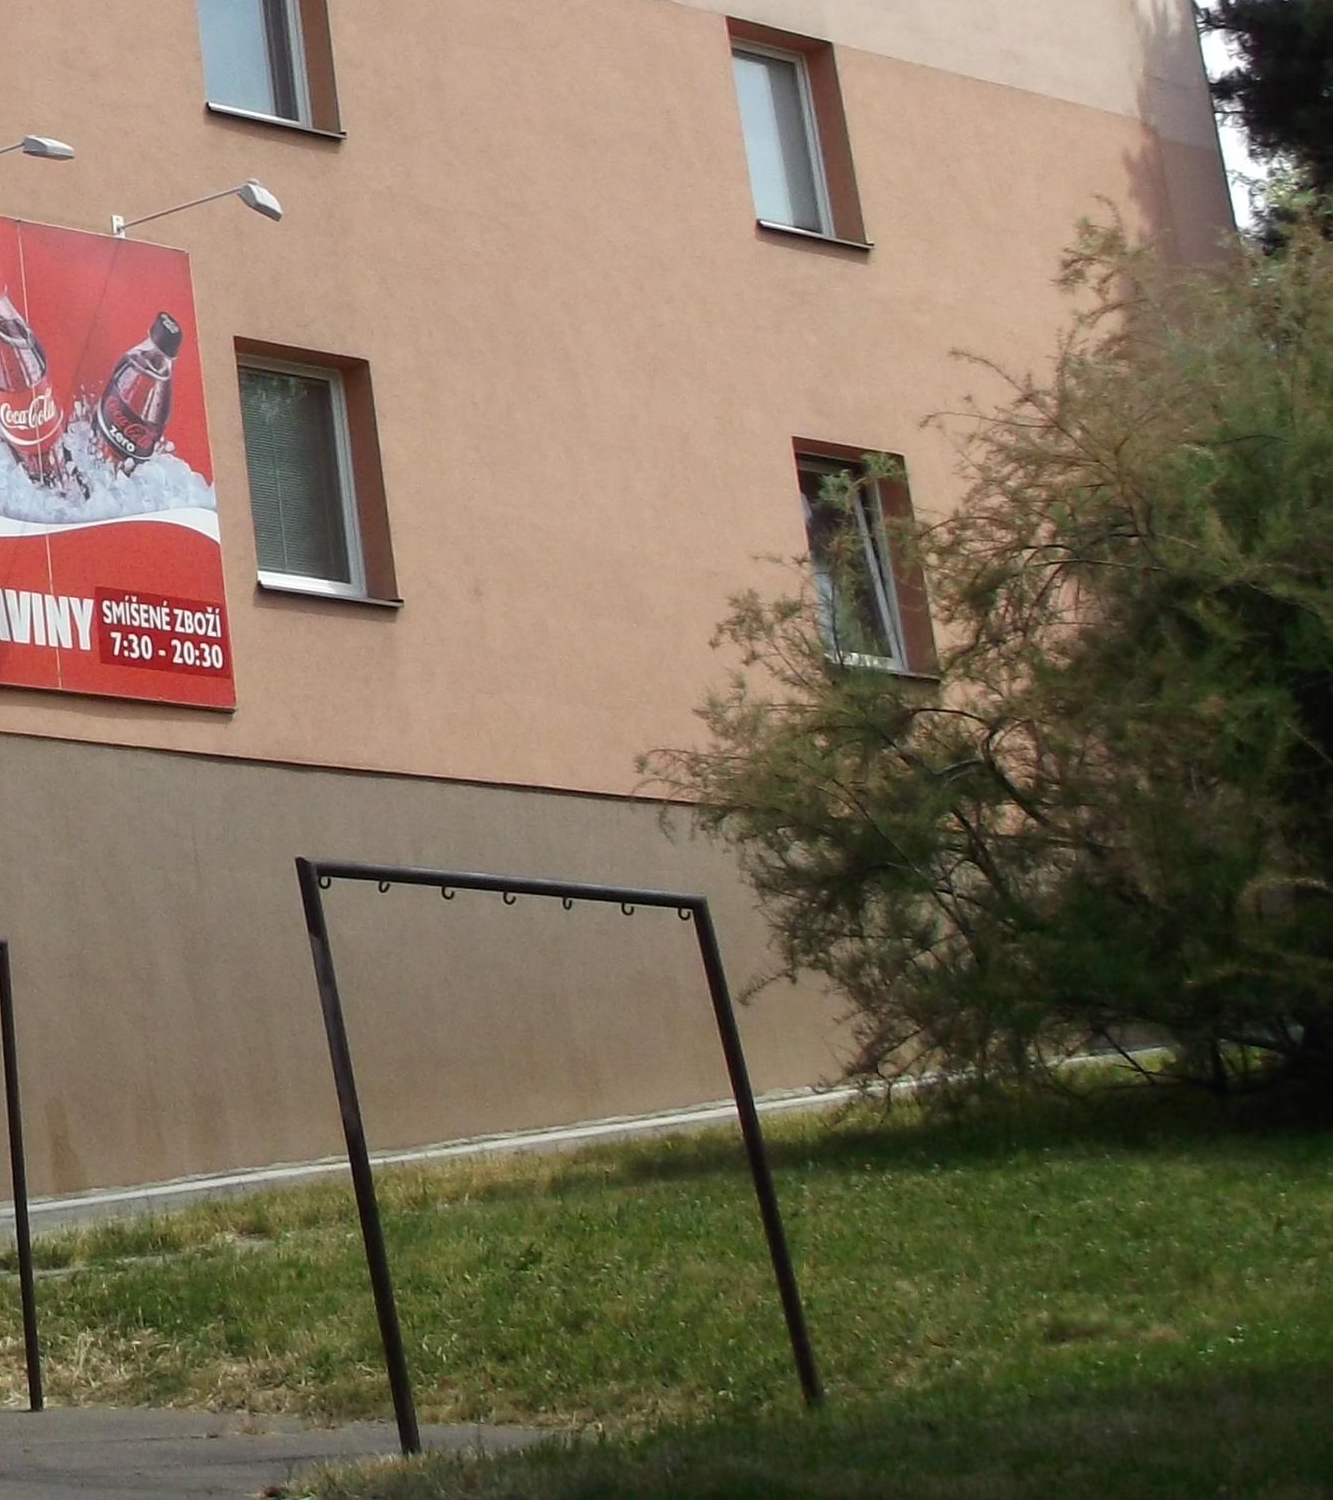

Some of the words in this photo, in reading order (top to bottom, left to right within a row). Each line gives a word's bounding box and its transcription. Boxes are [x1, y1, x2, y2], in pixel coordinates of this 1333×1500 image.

[109, 424, 136, 453] zero
[101, 595, 171, 632] SMÍŠENÉ
[173, 600, 222, 638] ZBOŽÍ
[109, 631, 153, 660] 7:30
[171, 639, 224, 670] 20:30
